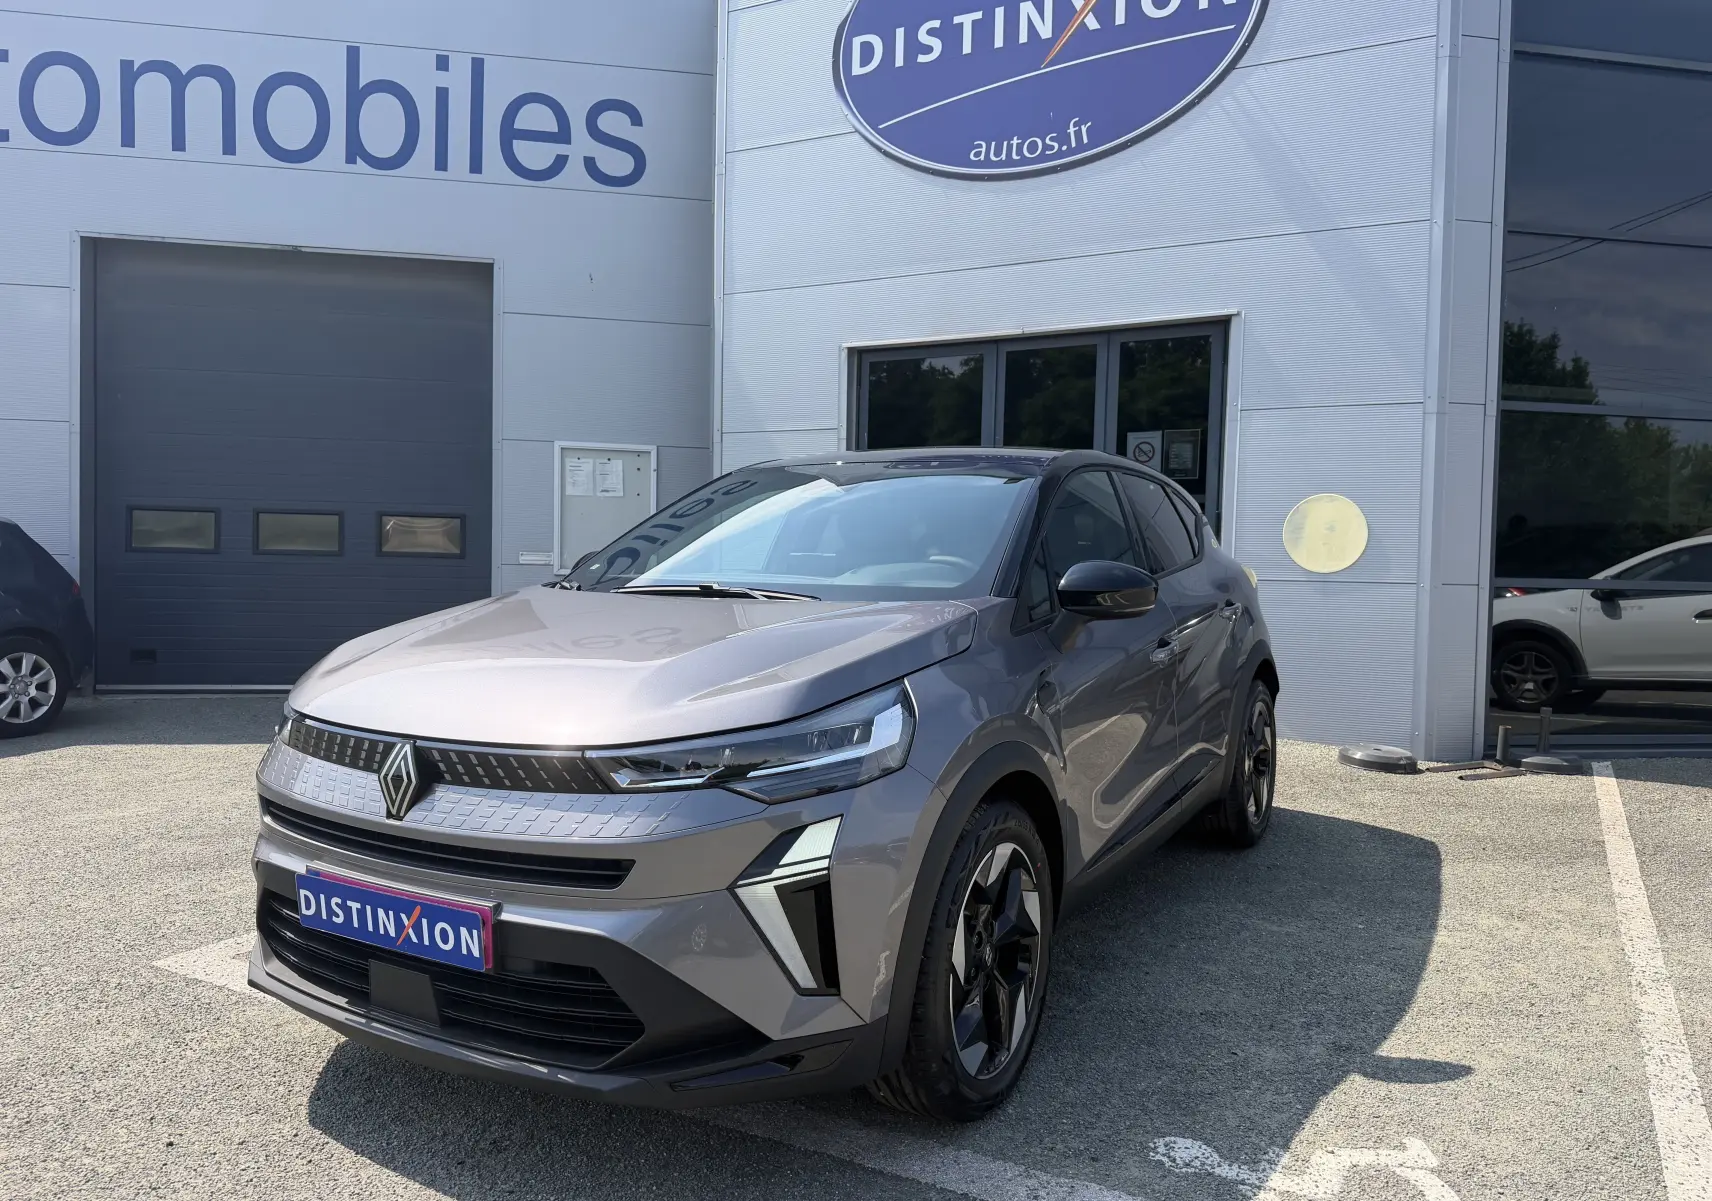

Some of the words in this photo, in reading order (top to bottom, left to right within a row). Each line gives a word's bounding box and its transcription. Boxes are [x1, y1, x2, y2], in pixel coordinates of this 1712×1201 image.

[851, 0, 1237, 76] DISTINXI
[0, 45, 647, 187] omobiles
[968, 117, 1092, 161] autos.fr
[300, 888, 480, 958] DISTINXION
